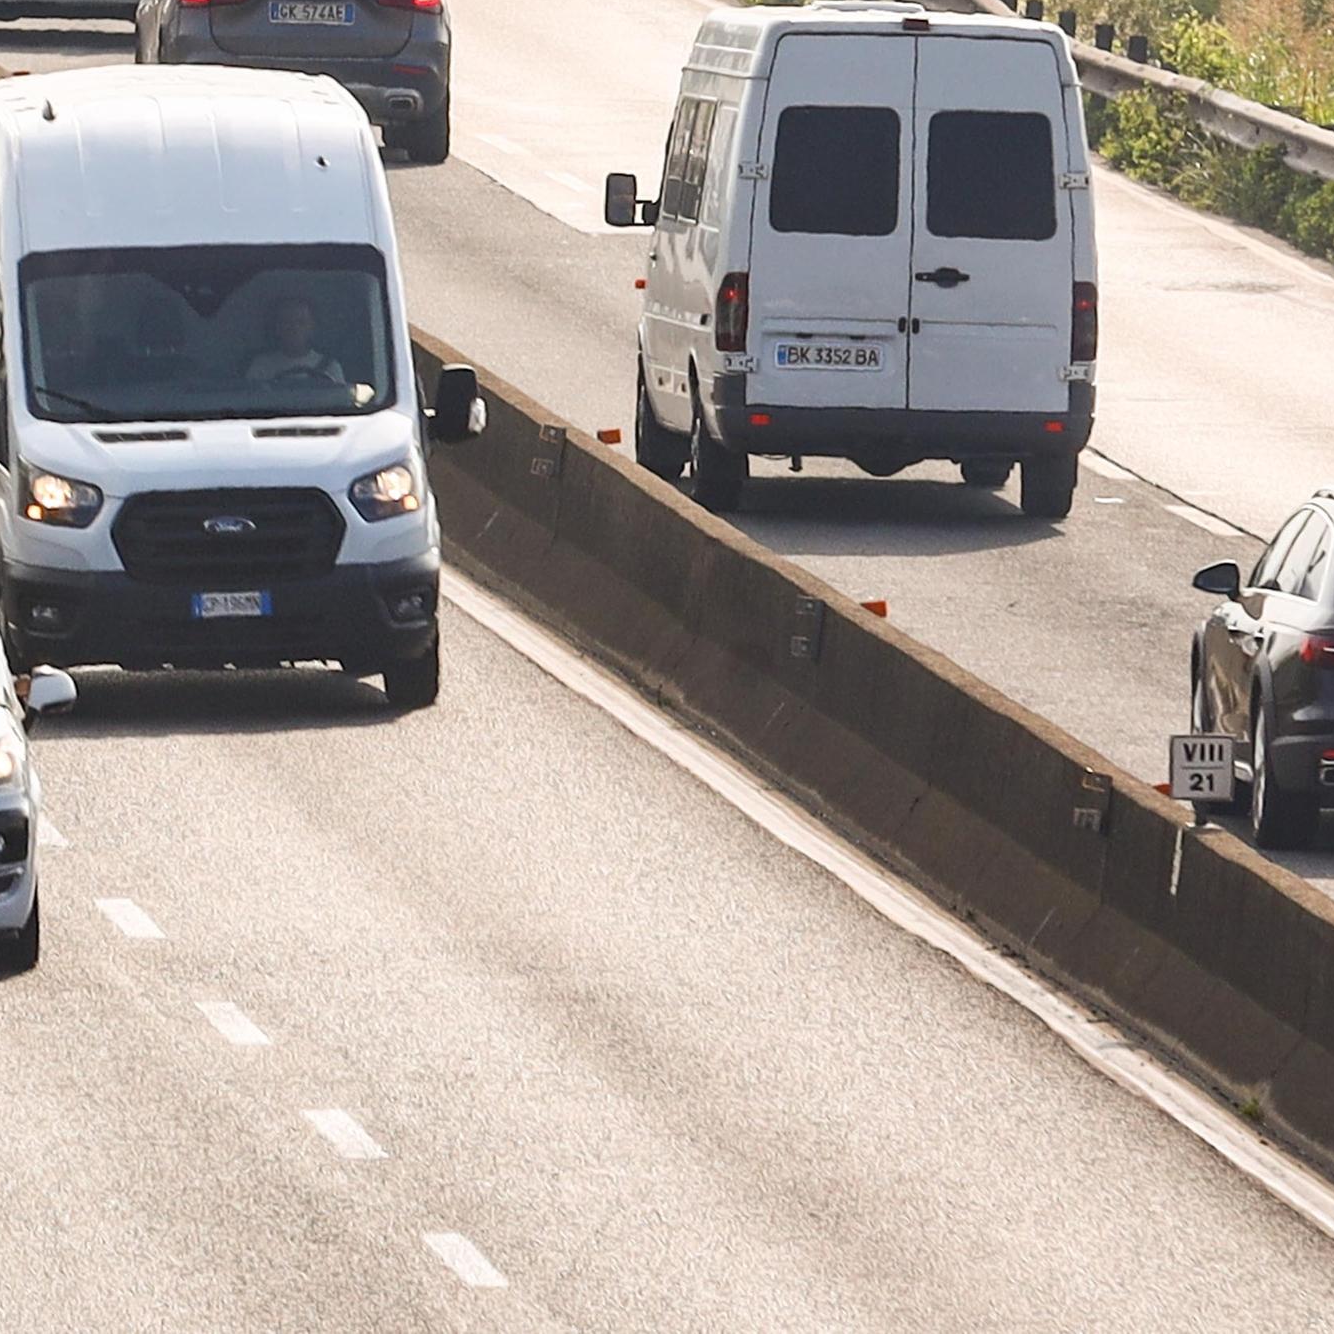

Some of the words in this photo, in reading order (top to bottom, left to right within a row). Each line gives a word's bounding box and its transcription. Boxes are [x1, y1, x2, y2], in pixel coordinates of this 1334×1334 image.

[788, 347, 809, 364] BK
[815, 348, 851, 365] 3352
[856, 349, 878, 366] BA
[1183, 743, 1223, 761] VIII
[1190, 773, 1214, 791] 21
